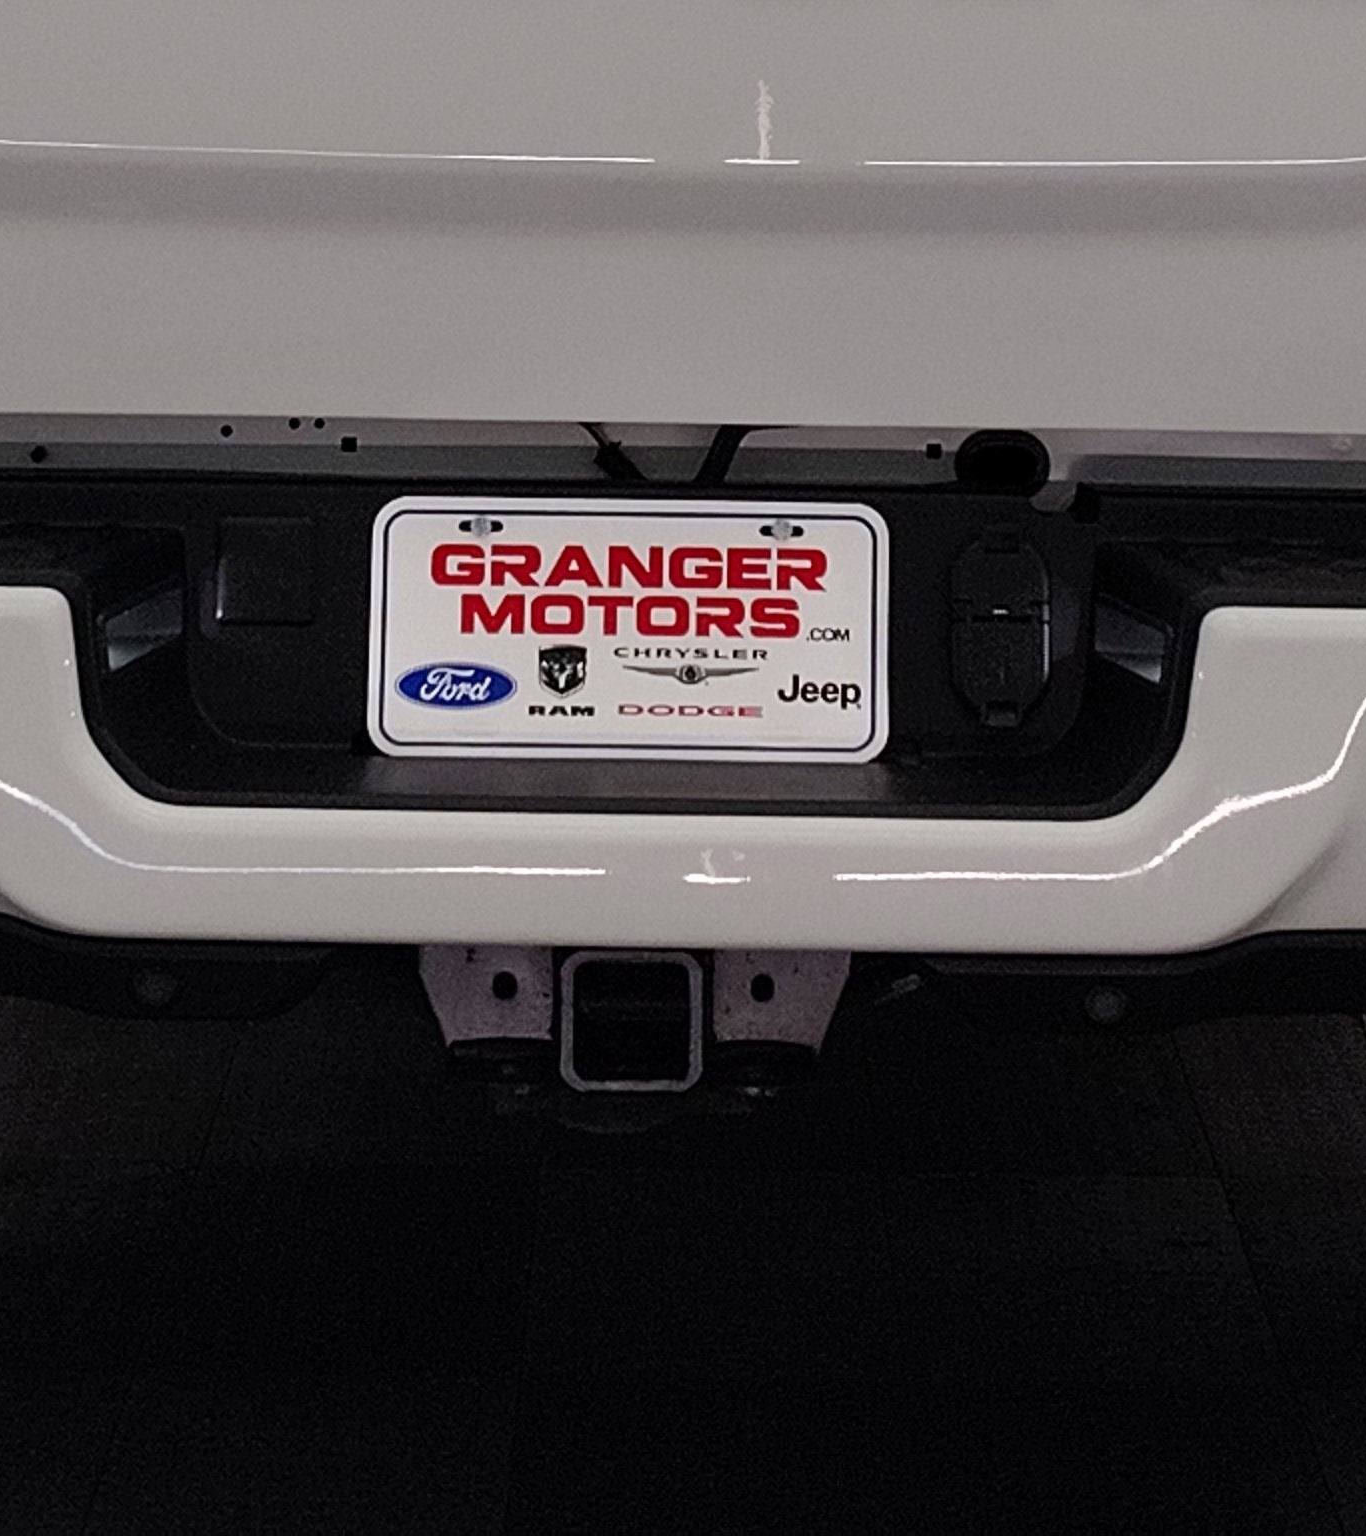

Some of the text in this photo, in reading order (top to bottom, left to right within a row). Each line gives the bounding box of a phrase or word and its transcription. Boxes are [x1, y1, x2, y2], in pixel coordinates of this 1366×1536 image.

[430, 543, 828, 592] GRANGER
[460, 594, 801, 639] MOTORS
[613, 647, 769, 661] CHRYSLER
[419, 667, 492, 702] Ford
[777, 674, 862, 710] Jeep
[528, 704, 596, 717] RAM
[617, 704, 764, 718] DODGE
